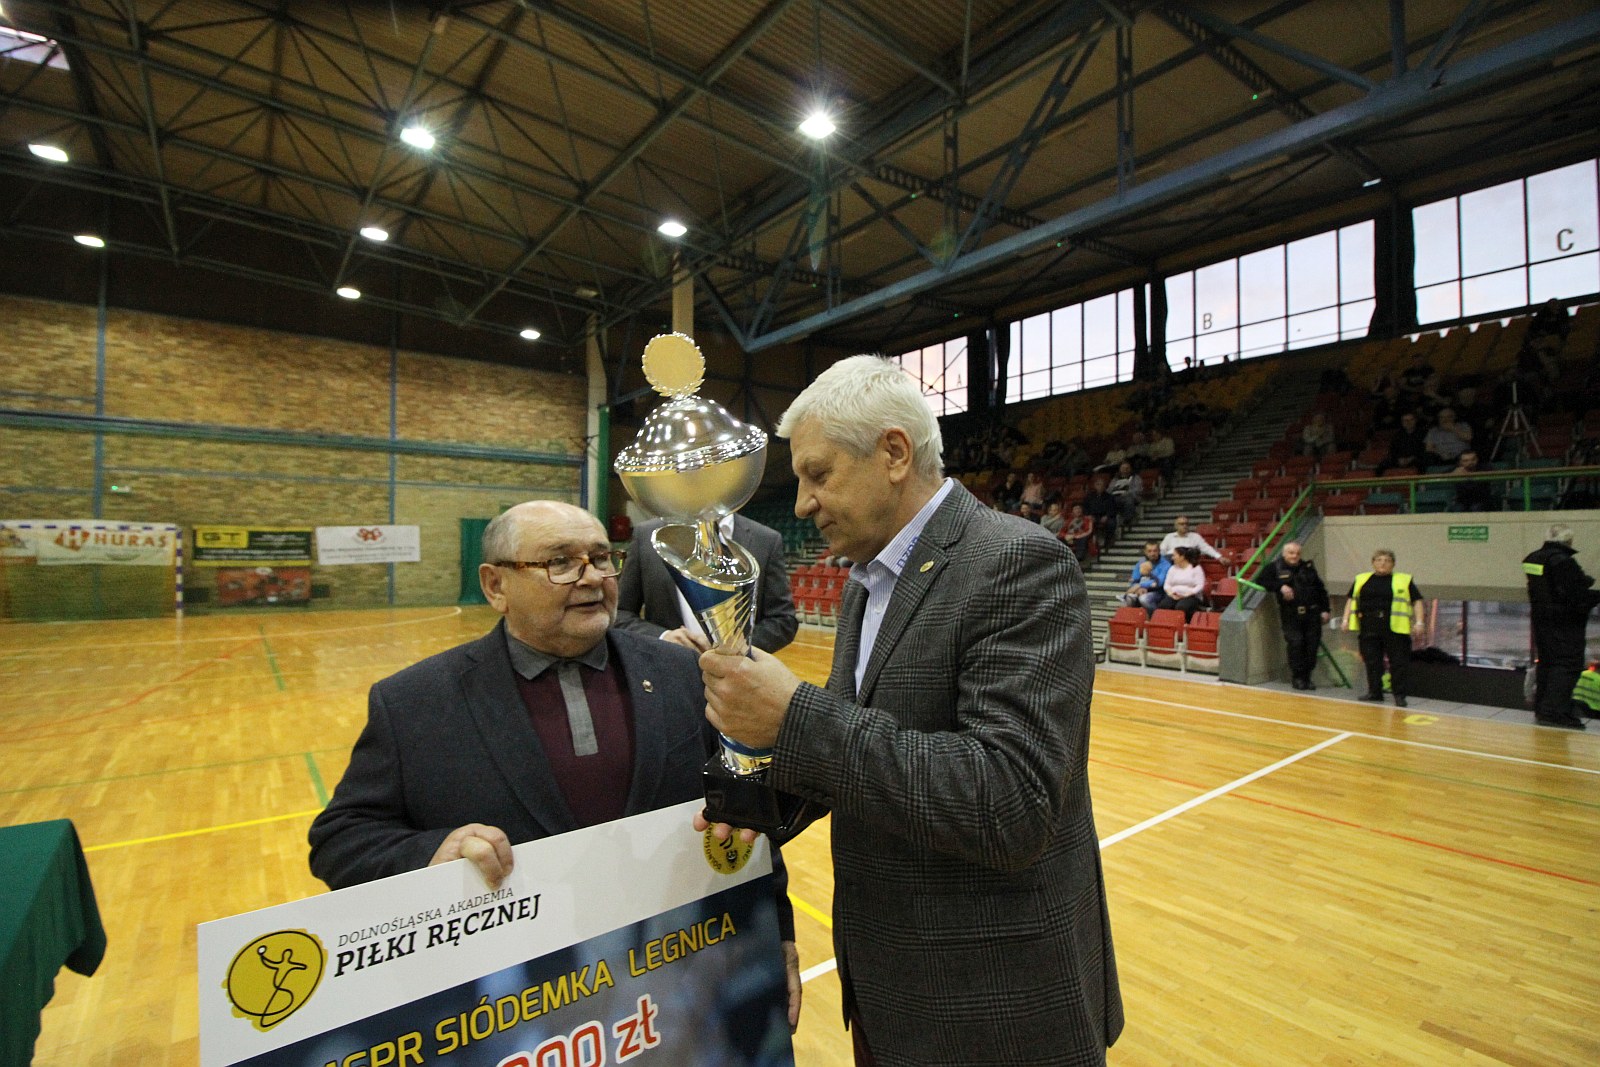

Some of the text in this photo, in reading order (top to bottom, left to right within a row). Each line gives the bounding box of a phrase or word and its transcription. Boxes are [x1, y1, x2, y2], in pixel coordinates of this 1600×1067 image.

[1556, 228, 1574, 252] C
[1203, 312, 1213, 330] B
[94, 533, 167, 548] HURAS
[334, 893, 542, 977] PIŁKI RĘCZNEJ
[337, 887, 514, 947] DOLNOŚLĄSKA AKADEMIA
[434, 959, 615, 1056] SIÓDEMKA
[628, 911, 737, 978] LEGNICA
[615, 996, 659, 1060] zł
